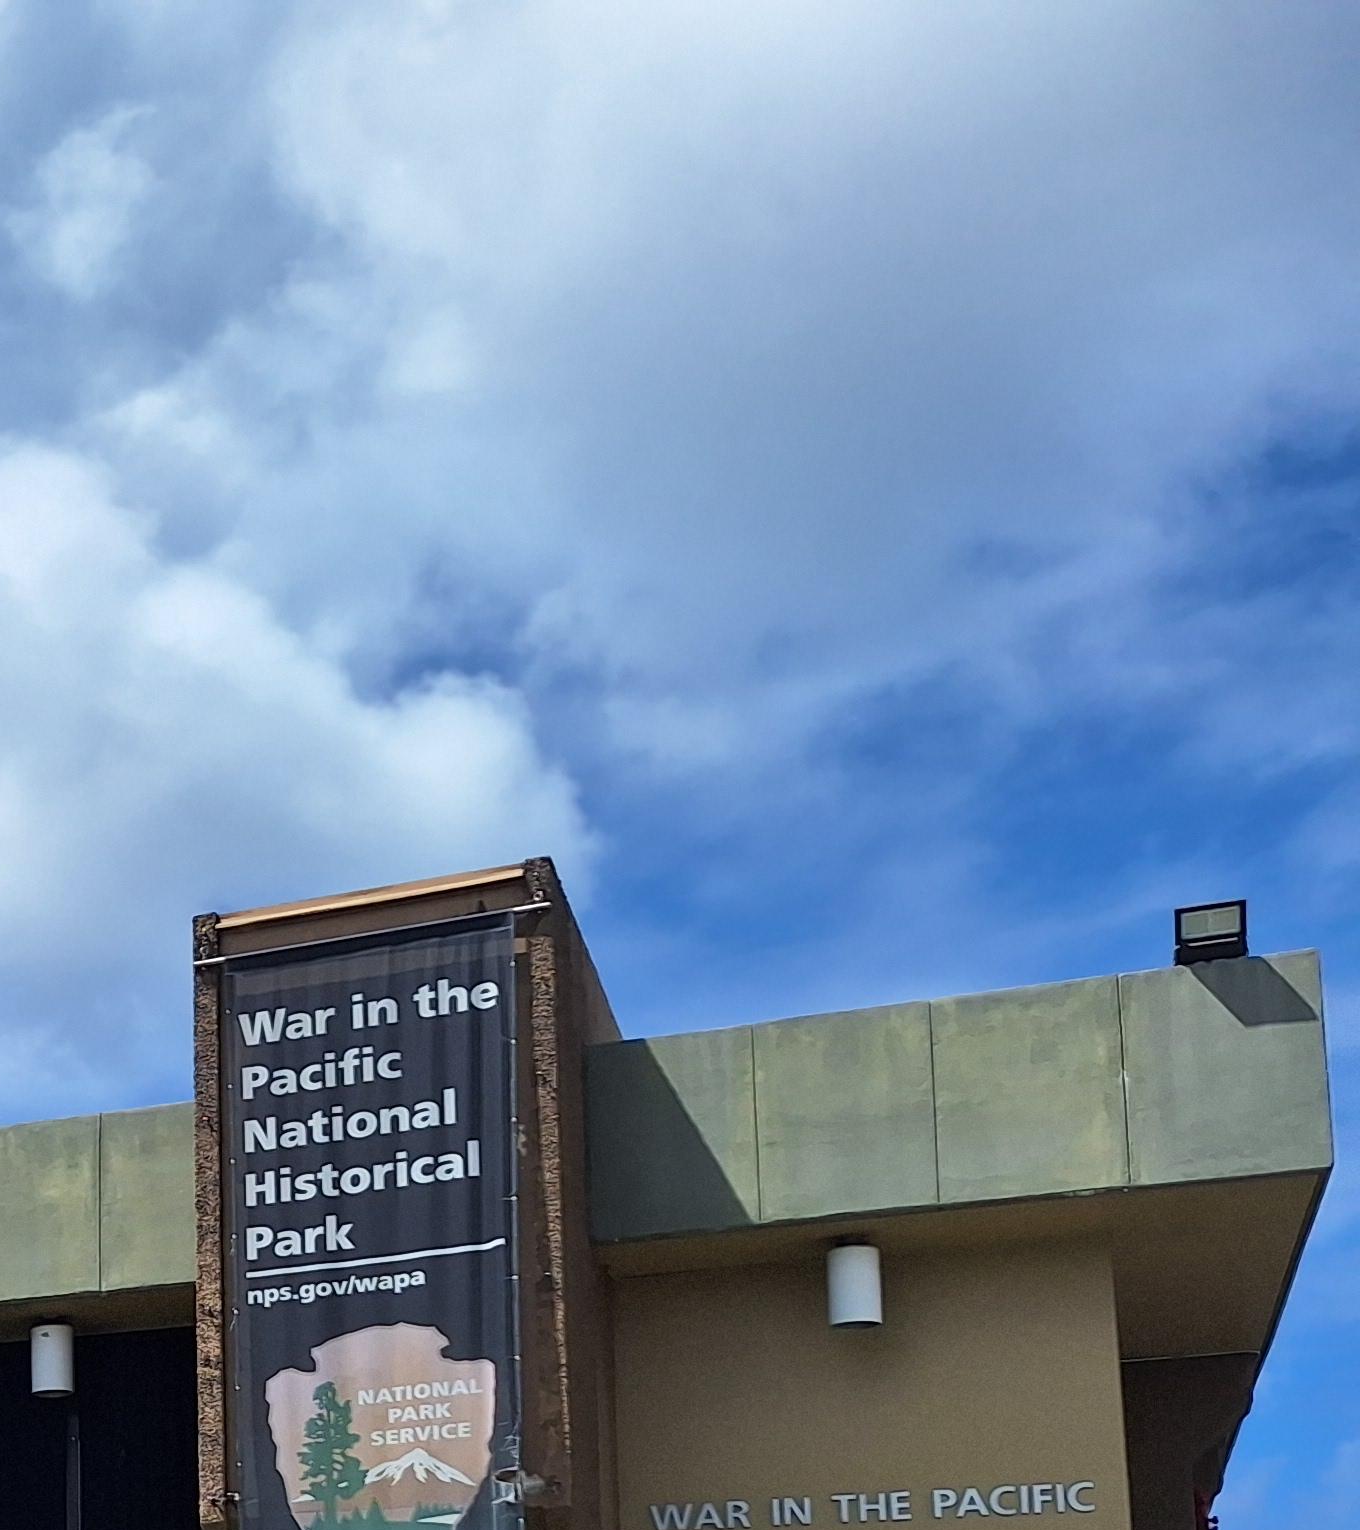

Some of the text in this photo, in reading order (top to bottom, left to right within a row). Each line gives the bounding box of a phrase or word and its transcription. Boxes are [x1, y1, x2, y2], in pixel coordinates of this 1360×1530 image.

[237, 978, 499, 1047] War in the
[241, 1046, 404, 1100] Pacific
[242, 1087, 457, 1154] National
[244, 1139, 480, 1207] Historical
[245, 1214, 356, 1261] Park
[246, 1269, 426, 1308] nps.gov/wapa
[357, 1378, 483, 1406] NATIONAL
[387, 1402, 452, 1424] PARK
[370, 1422, 472, 1447] SERVICE
[771, 1496, 812, 1527] IN
[830, 1490, 912, 1524] THE
[932, 1481, 1096, 1519] PACIFIC
